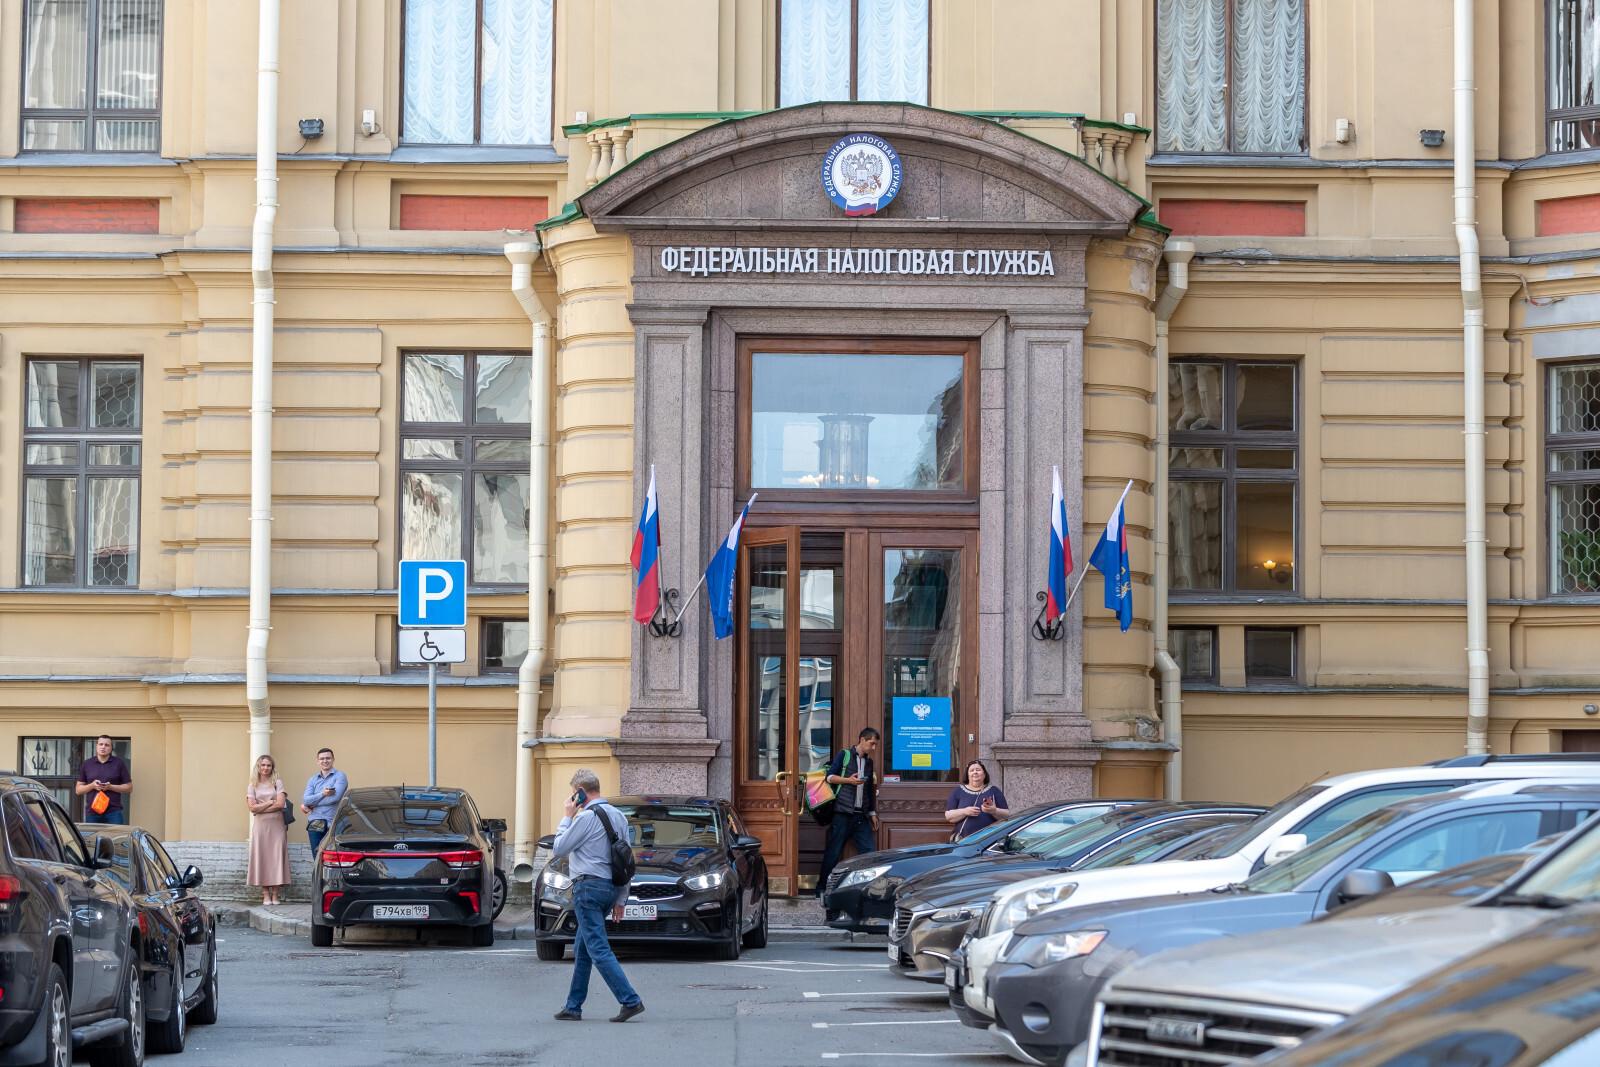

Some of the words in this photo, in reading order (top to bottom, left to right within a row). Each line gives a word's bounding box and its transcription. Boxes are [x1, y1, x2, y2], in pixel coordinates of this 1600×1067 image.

[823, 141, 847, 198] ФЕДЕРАЛЬНАЯ
[849, 135, 896, 160] НАЛОГОВАЯ
[886, 163, 901, 198] СЛУЖБА
[661, 246, 818, 277] ФЕДЕРАЛЬНАЯ
[827, 248, 954, 275] НАЛОГОВАЯ
[962, 249, 1055, 276] СЛУЖБА
[418, 568, 454, 619] P
[640, 905, 655, 914] 198
